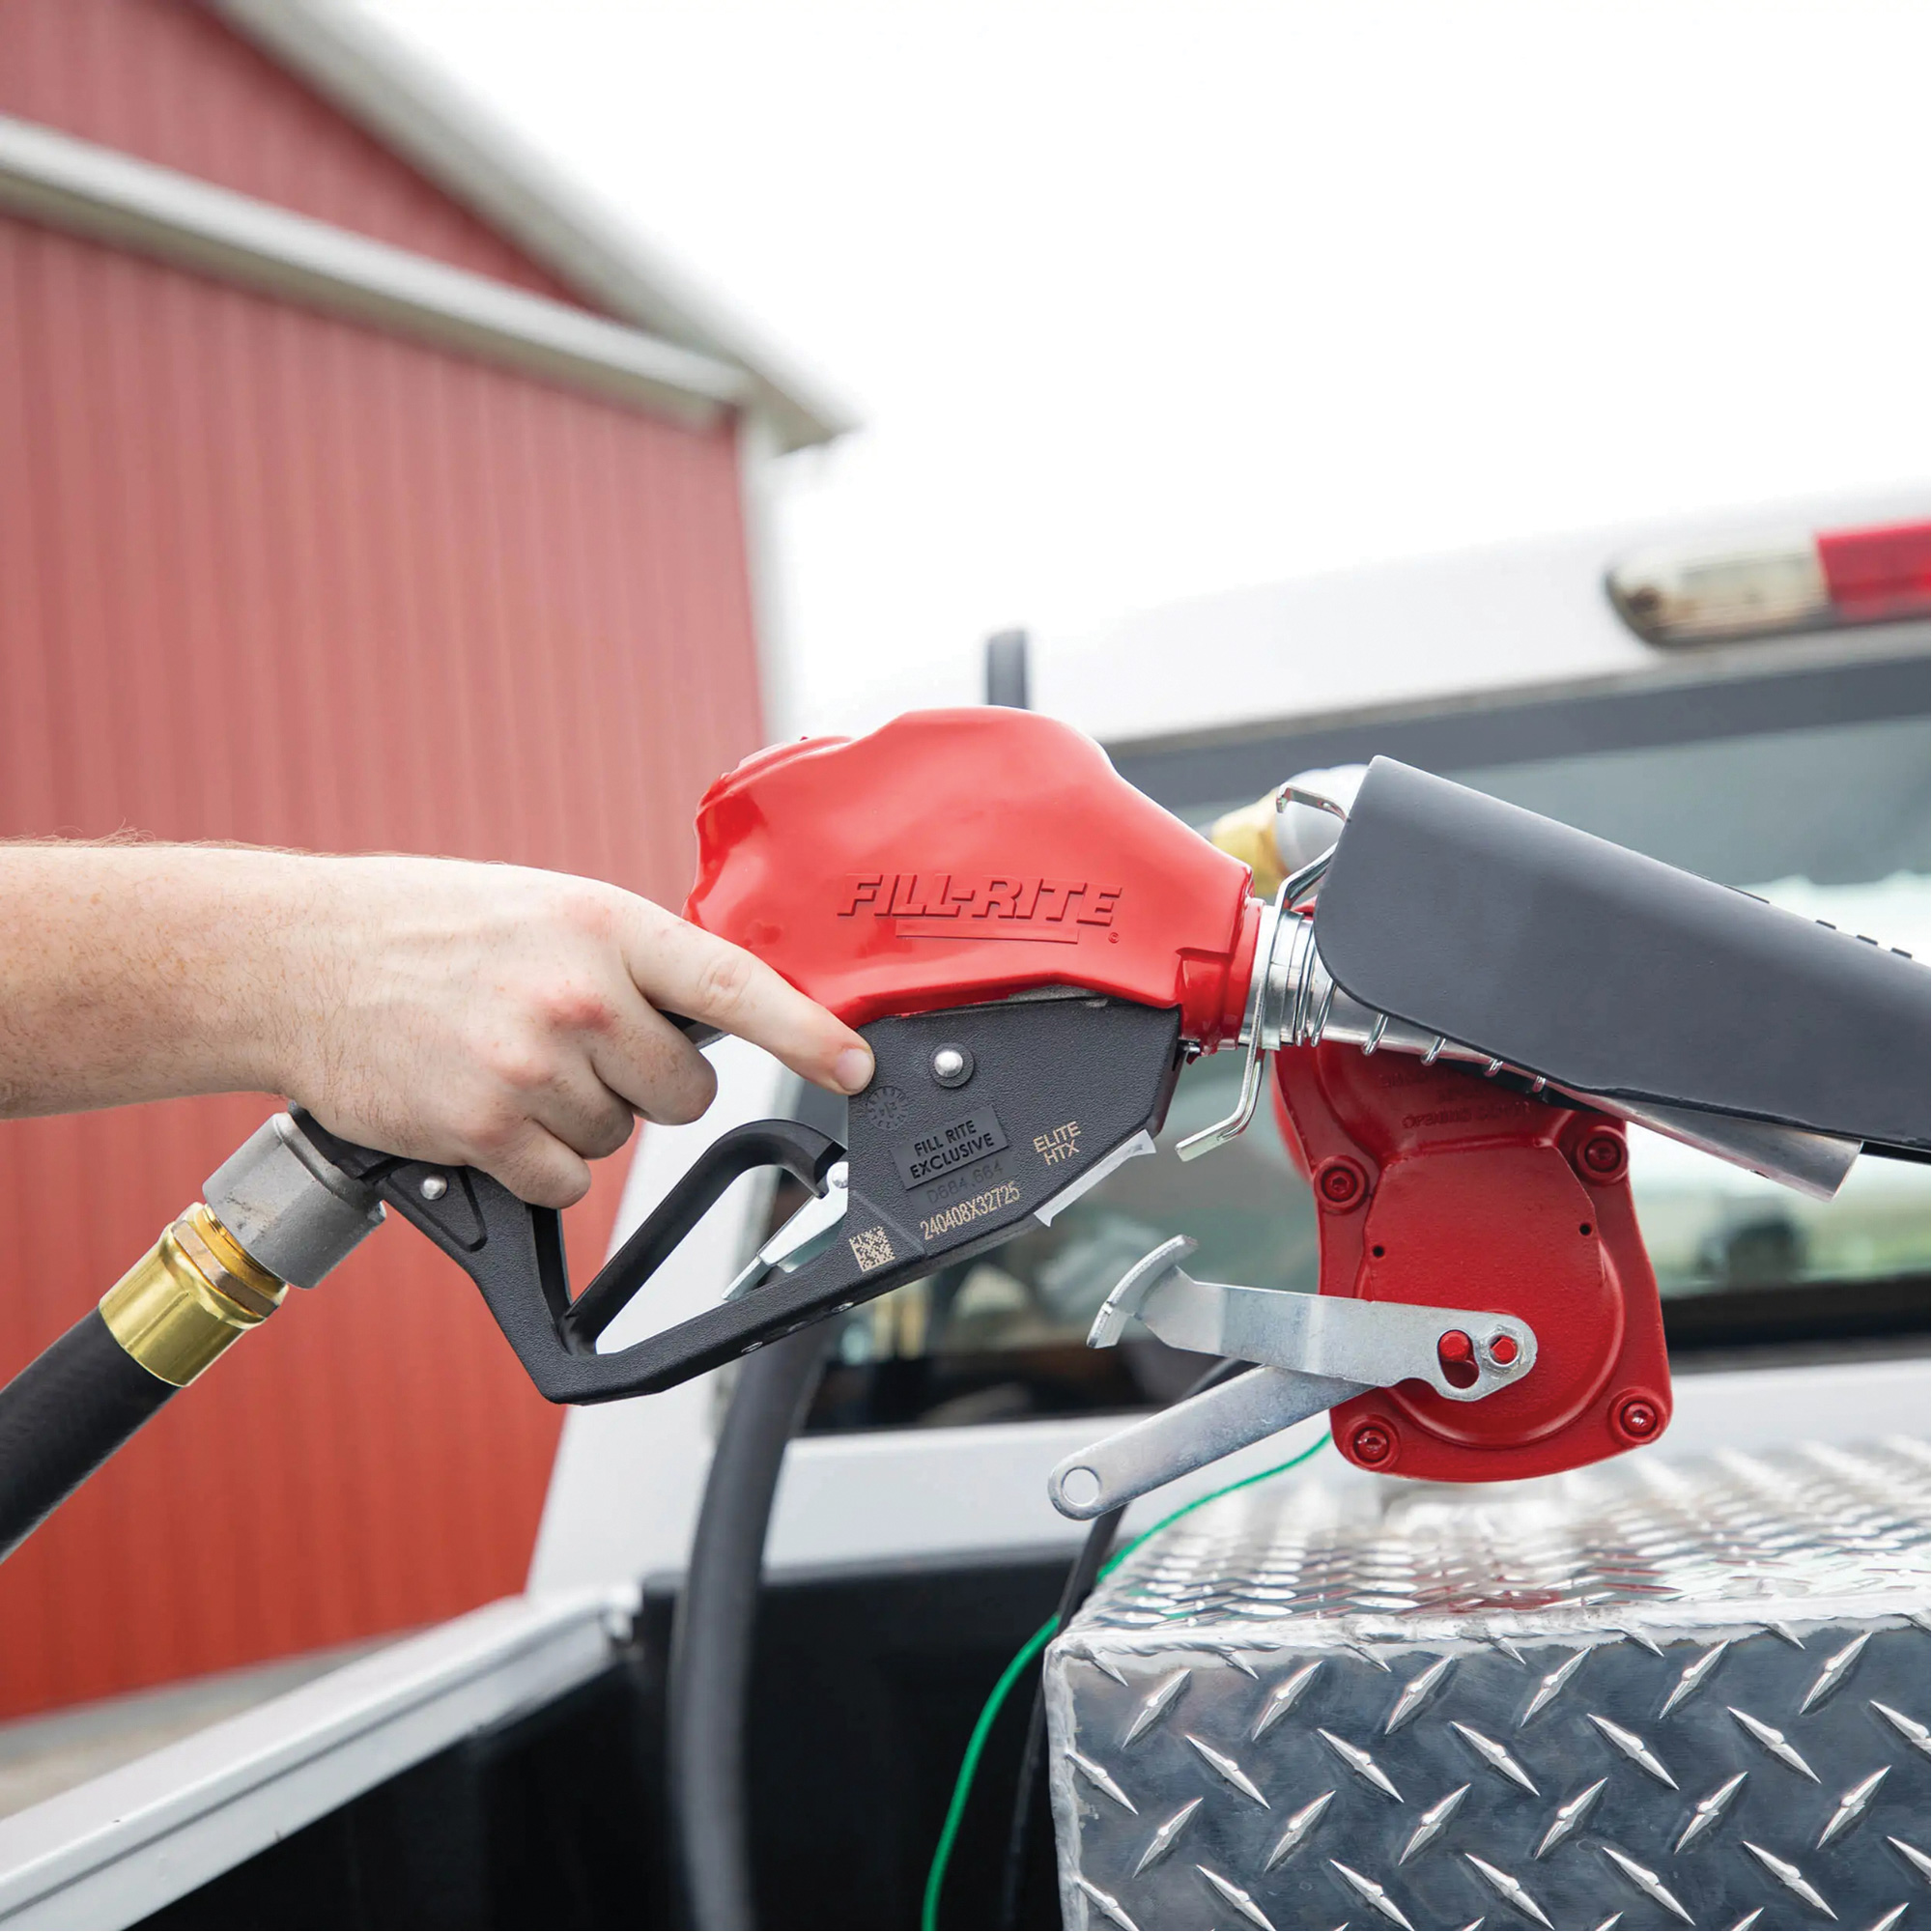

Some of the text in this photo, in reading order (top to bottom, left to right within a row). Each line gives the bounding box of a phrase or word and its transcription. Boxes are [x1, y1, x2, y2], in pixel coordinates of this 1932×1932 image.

[837, 873, 1122, 927] FILL-RITE
[909, 1132, 995, 1179] EXCLUSIVE
[914, 1120, 977, 1157] FILL RITE
[1033, 1121, 1082, 1153] ELITE
[1042, 1139, 1081, 1166] HTX
[920, 1181, 1021, 1241] 240408X32725
